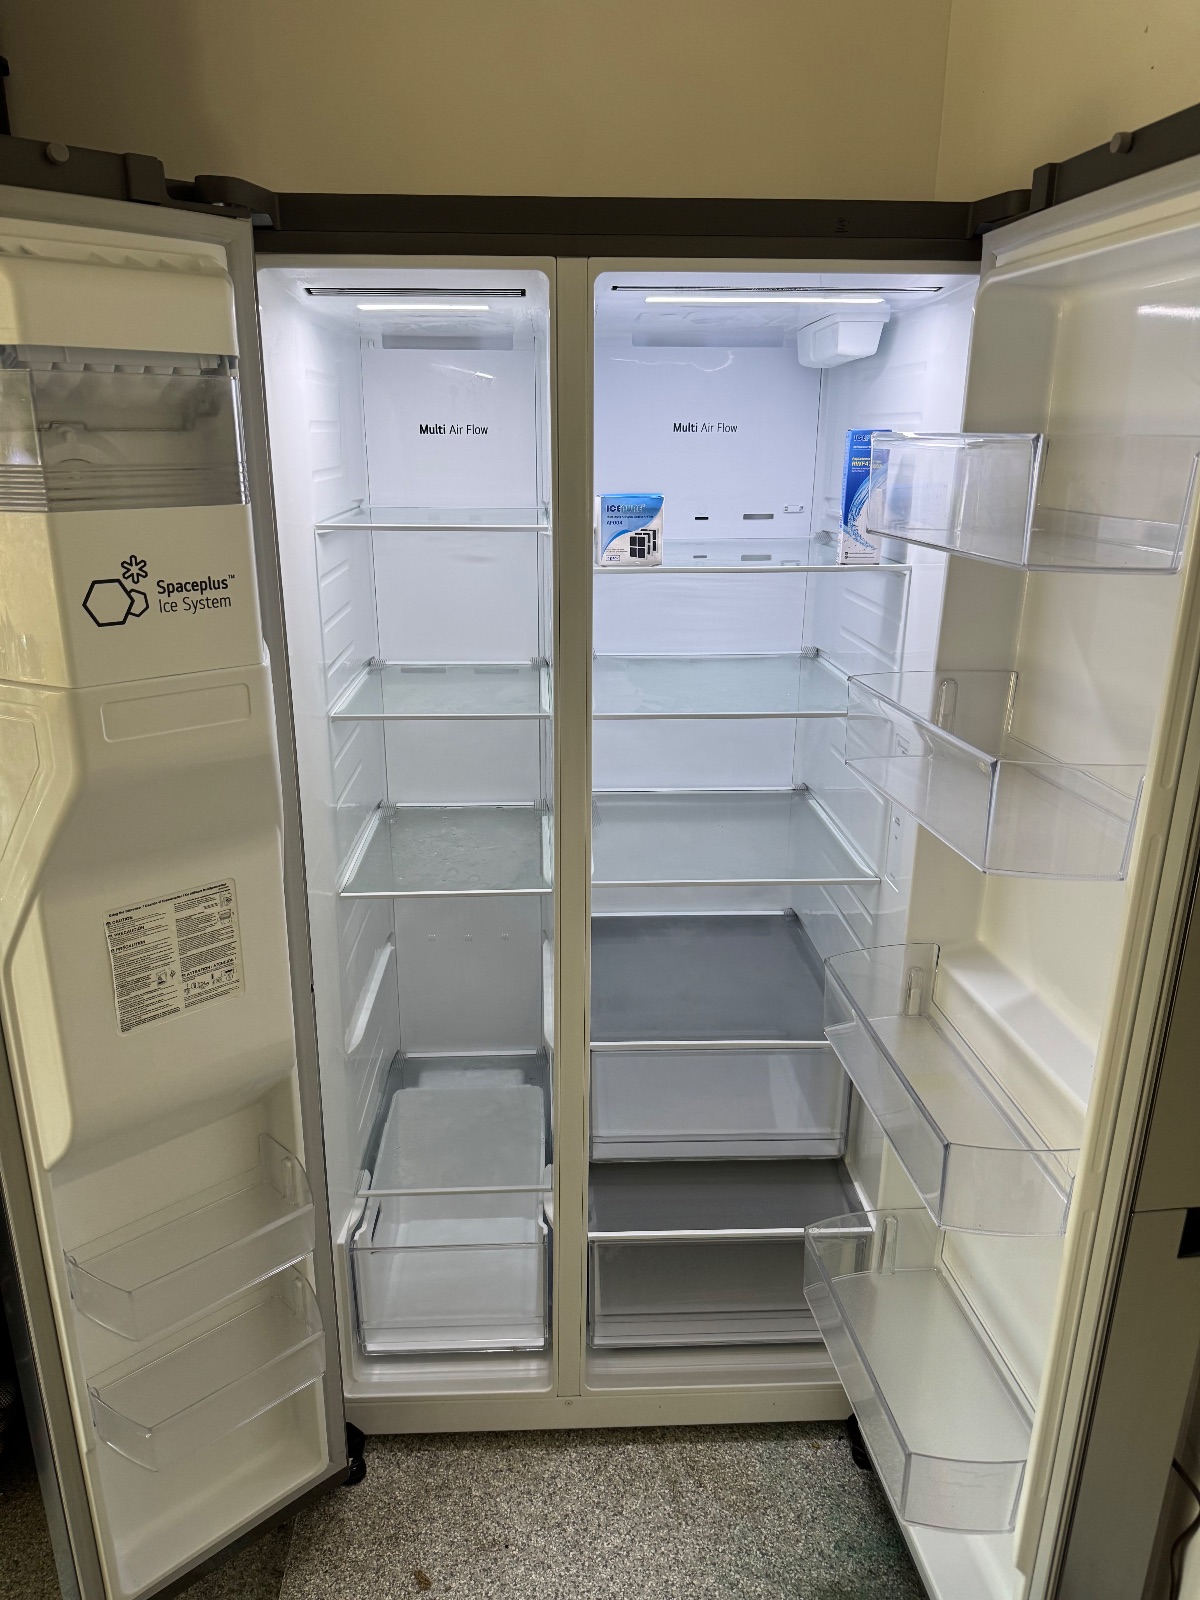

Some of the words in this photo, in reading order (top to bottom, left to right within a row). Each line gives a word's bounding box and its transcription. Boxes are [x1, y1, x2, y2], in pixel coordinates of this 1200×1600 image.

[419, 424, 446, 435] Multi
[449, 424, 463, 435] Air
[466, 424, 489, 435] Flow
[674, 422, 698, 433] Multi
[700, 422, 714, 433] Air
[717, 422, 738, 433] Flow
[158, 598, 178, 614] Ice
[182, 596, 232, 615] System
